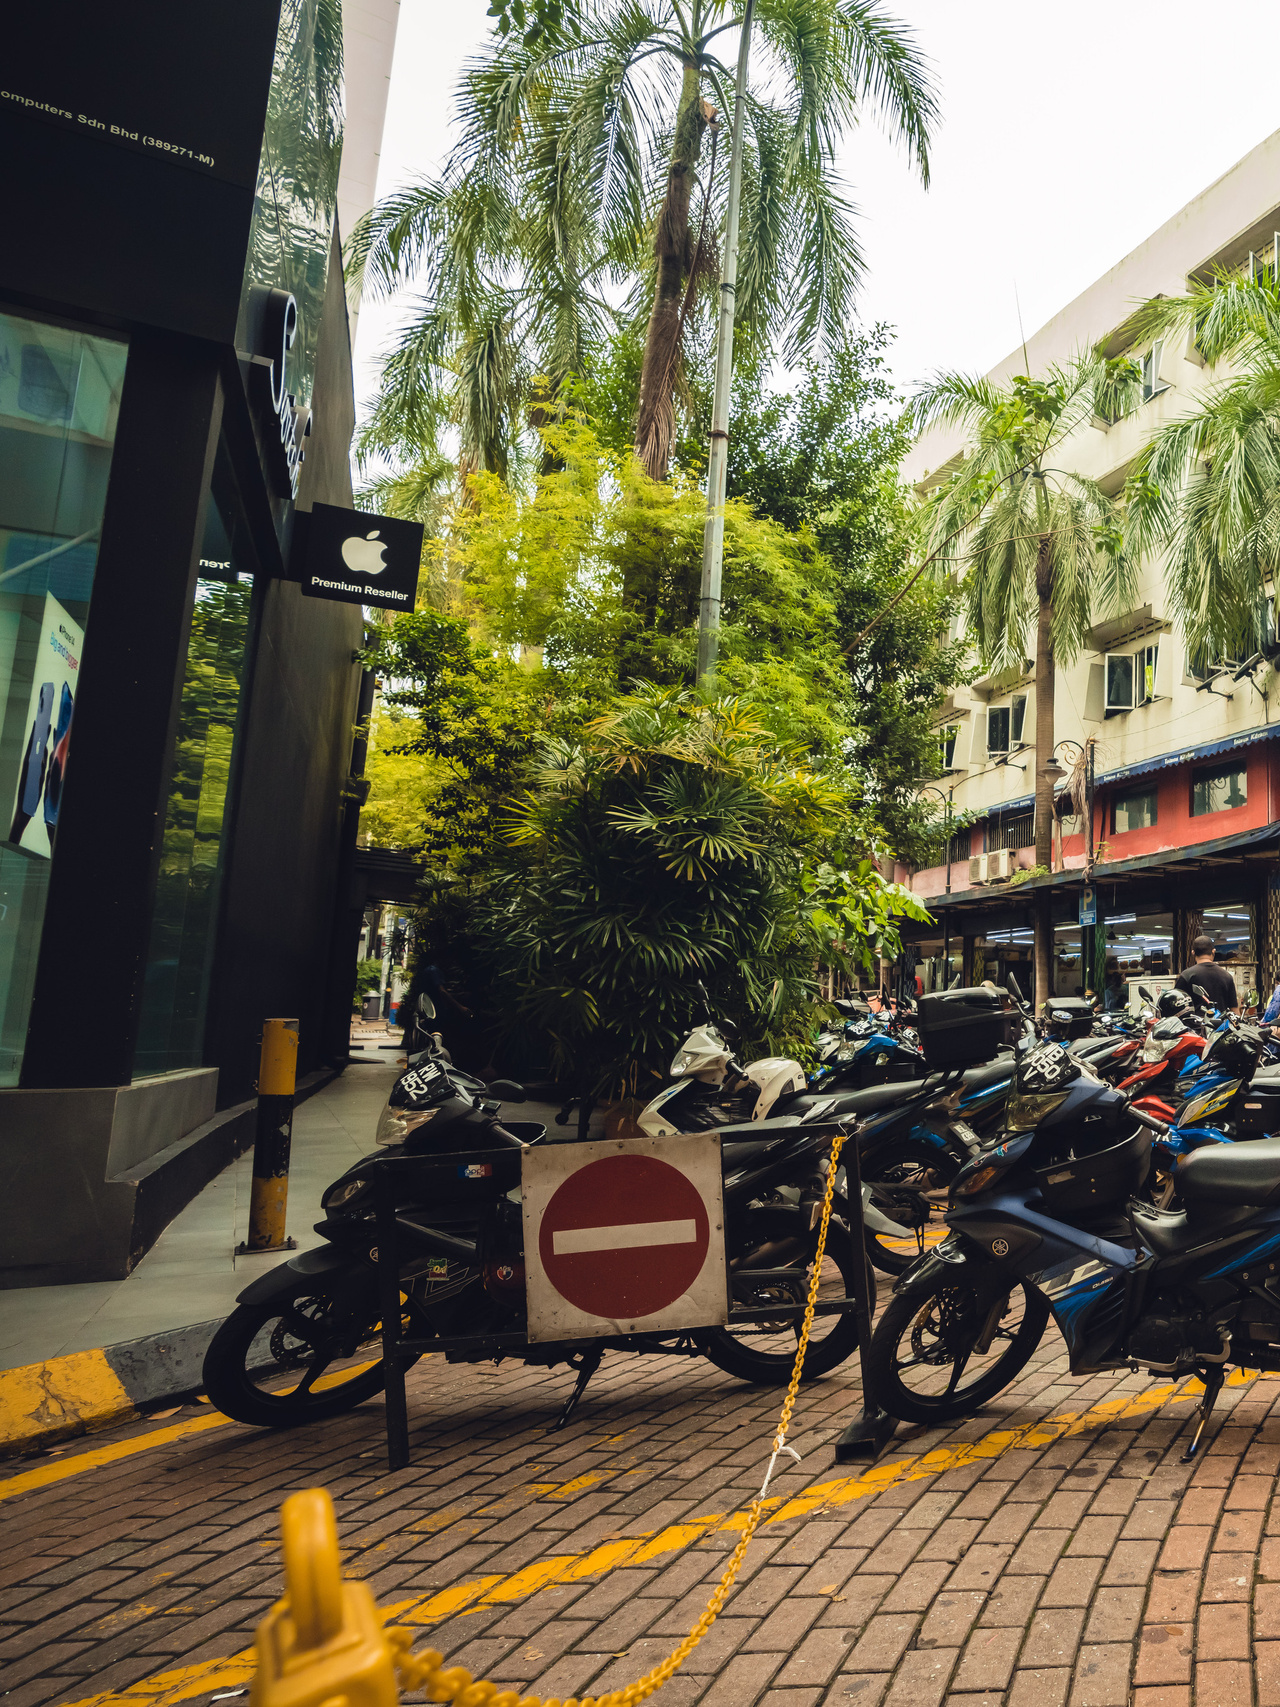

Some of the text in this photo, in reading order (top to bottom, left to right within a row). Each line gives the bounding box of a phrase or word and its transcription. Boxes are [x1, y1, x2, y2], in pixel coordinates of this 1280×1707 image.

[77, 114, 106, 131] Sdn
[110, 124, 139, 141] Bhd
[142, 135, 215, 168] (389271-M)
[311, 576, 409, 602] Premium Reseller
[1083, 888, 1093, 911] P
[418, 1062, 441, 1083] RW
[1023, 1066, 1039, 1081] V
[400, 1070, 428, 1101] 1952
